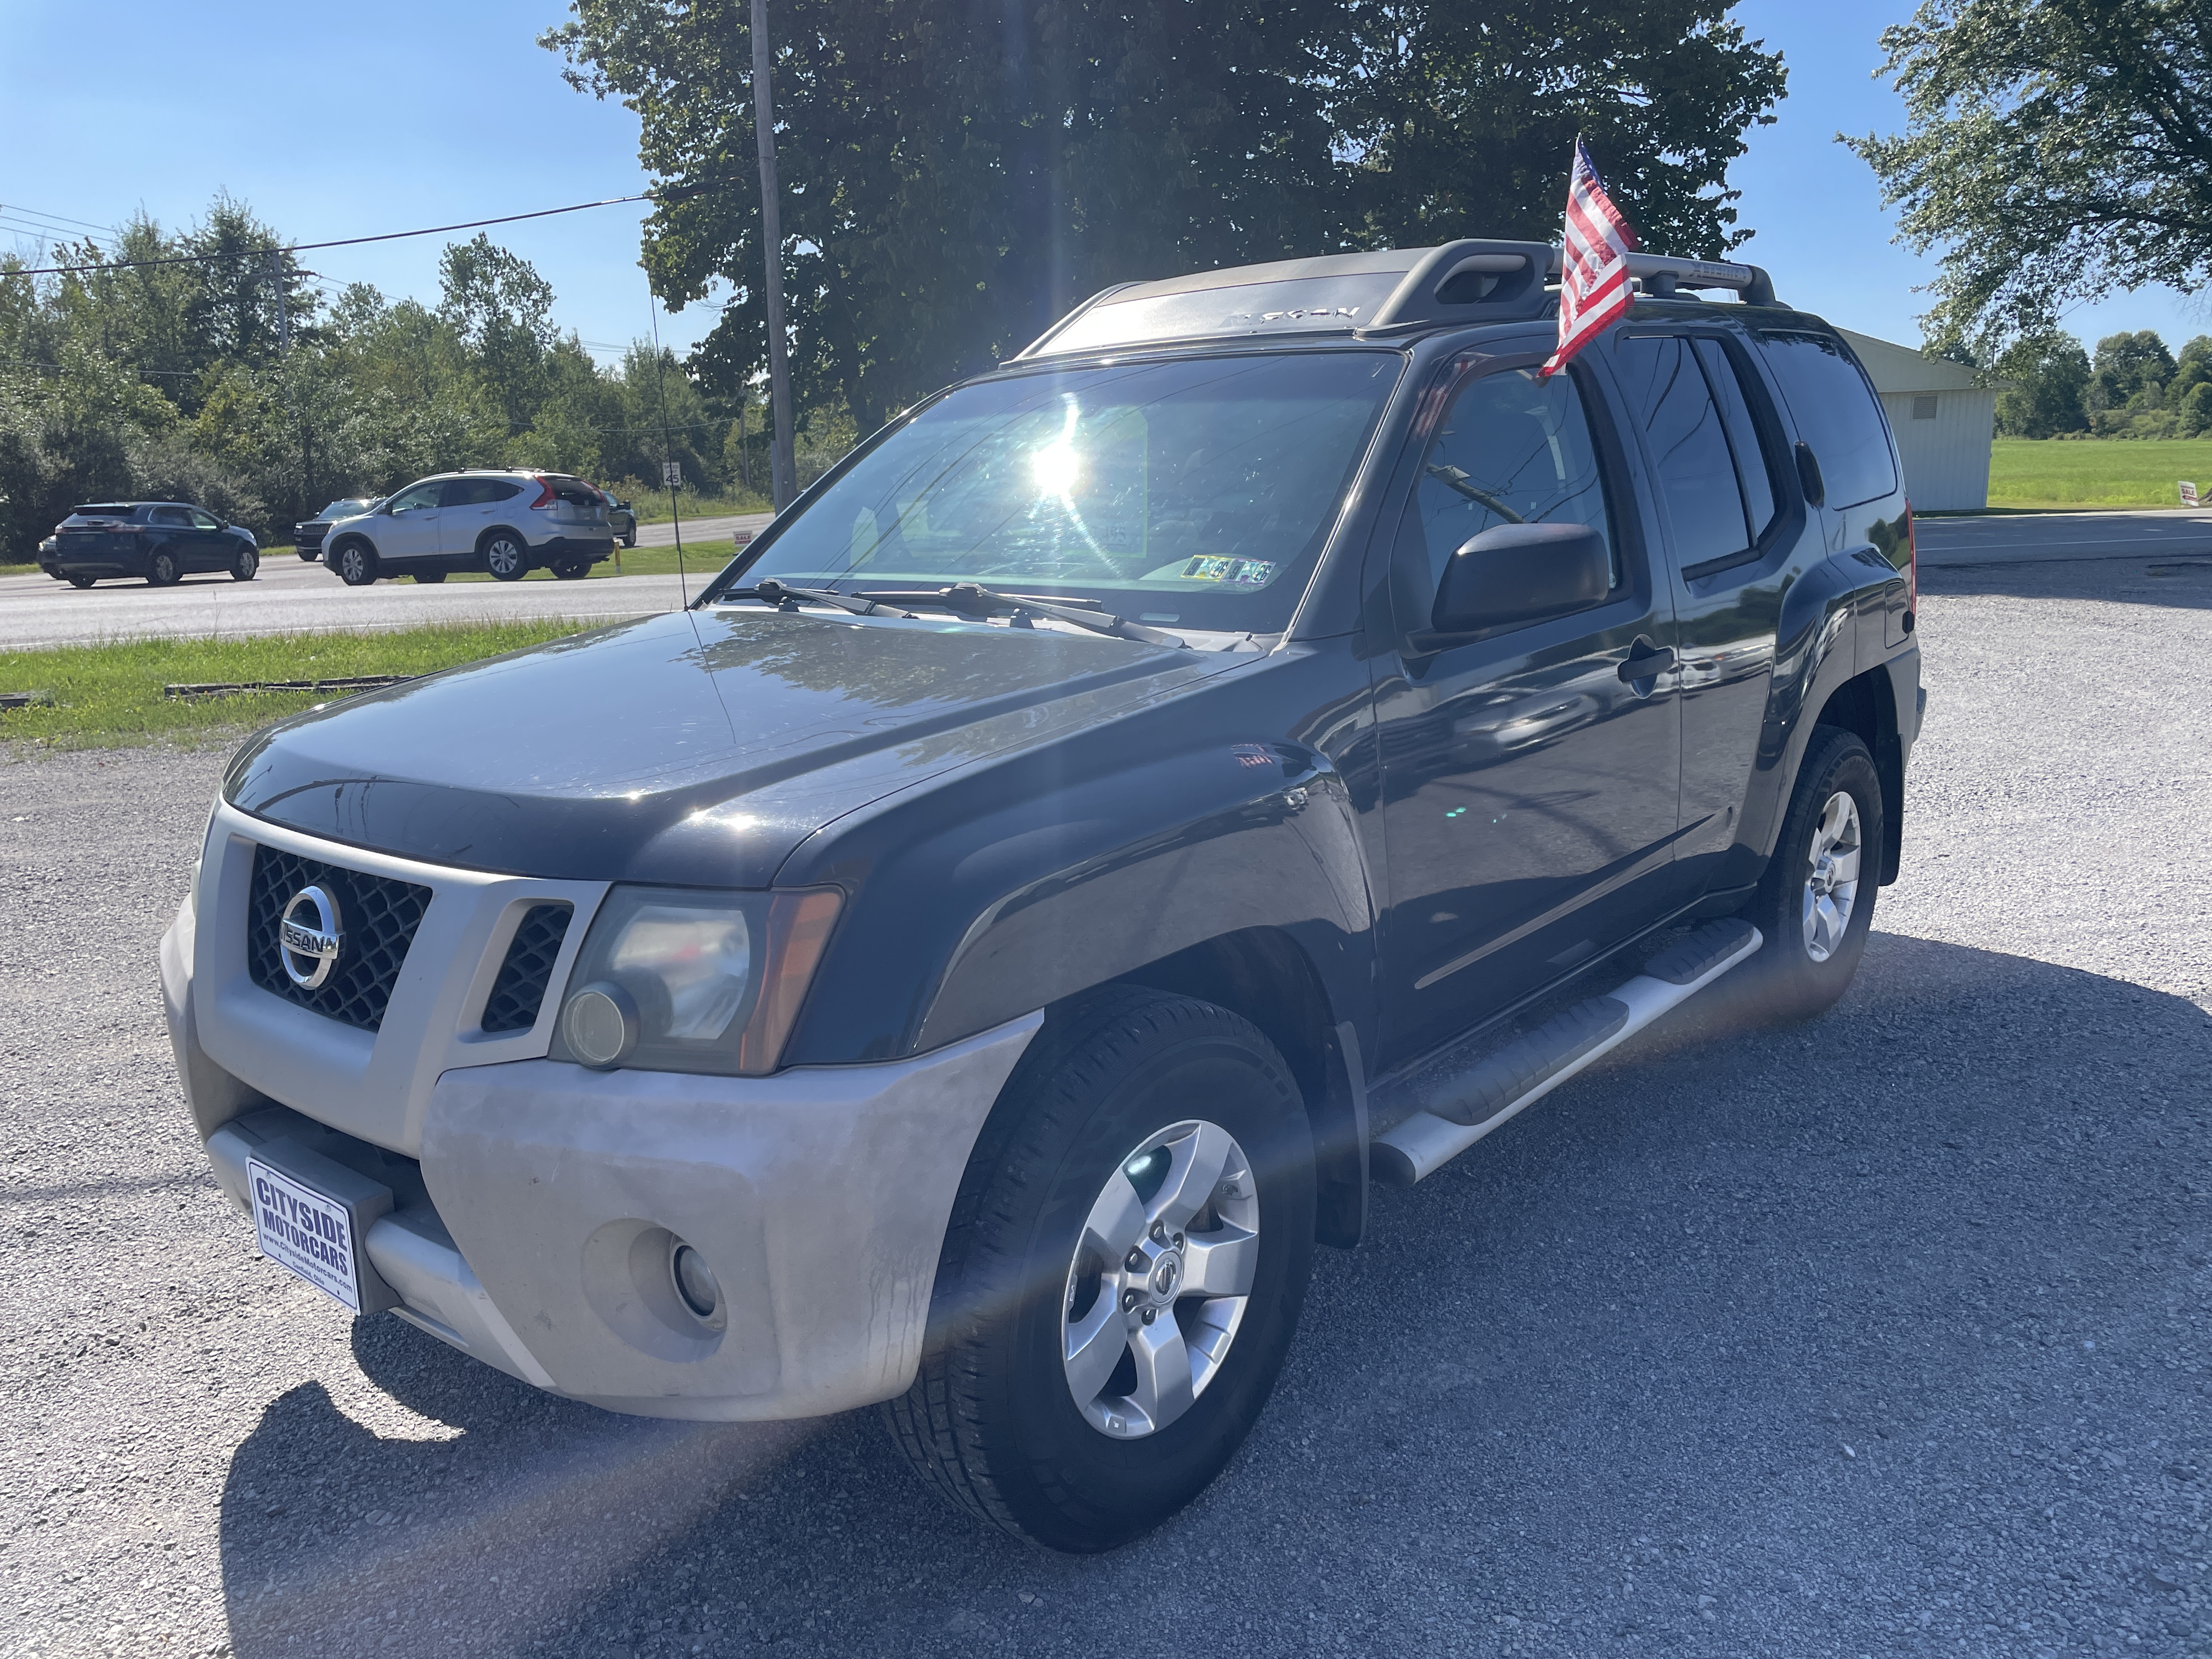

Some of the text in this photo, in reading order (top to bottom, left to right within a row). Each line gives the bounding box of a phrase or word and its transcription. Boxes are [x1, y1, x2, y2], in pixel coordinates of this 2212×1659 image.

[665, 474, 679, 483] 45
[256, 1177, 348, 1252] CITYSIDE
[262, 1207, 348, 1276] MOTORCARS
[263, 1233, 353, 1294] www.CitysideMotorcars.com
